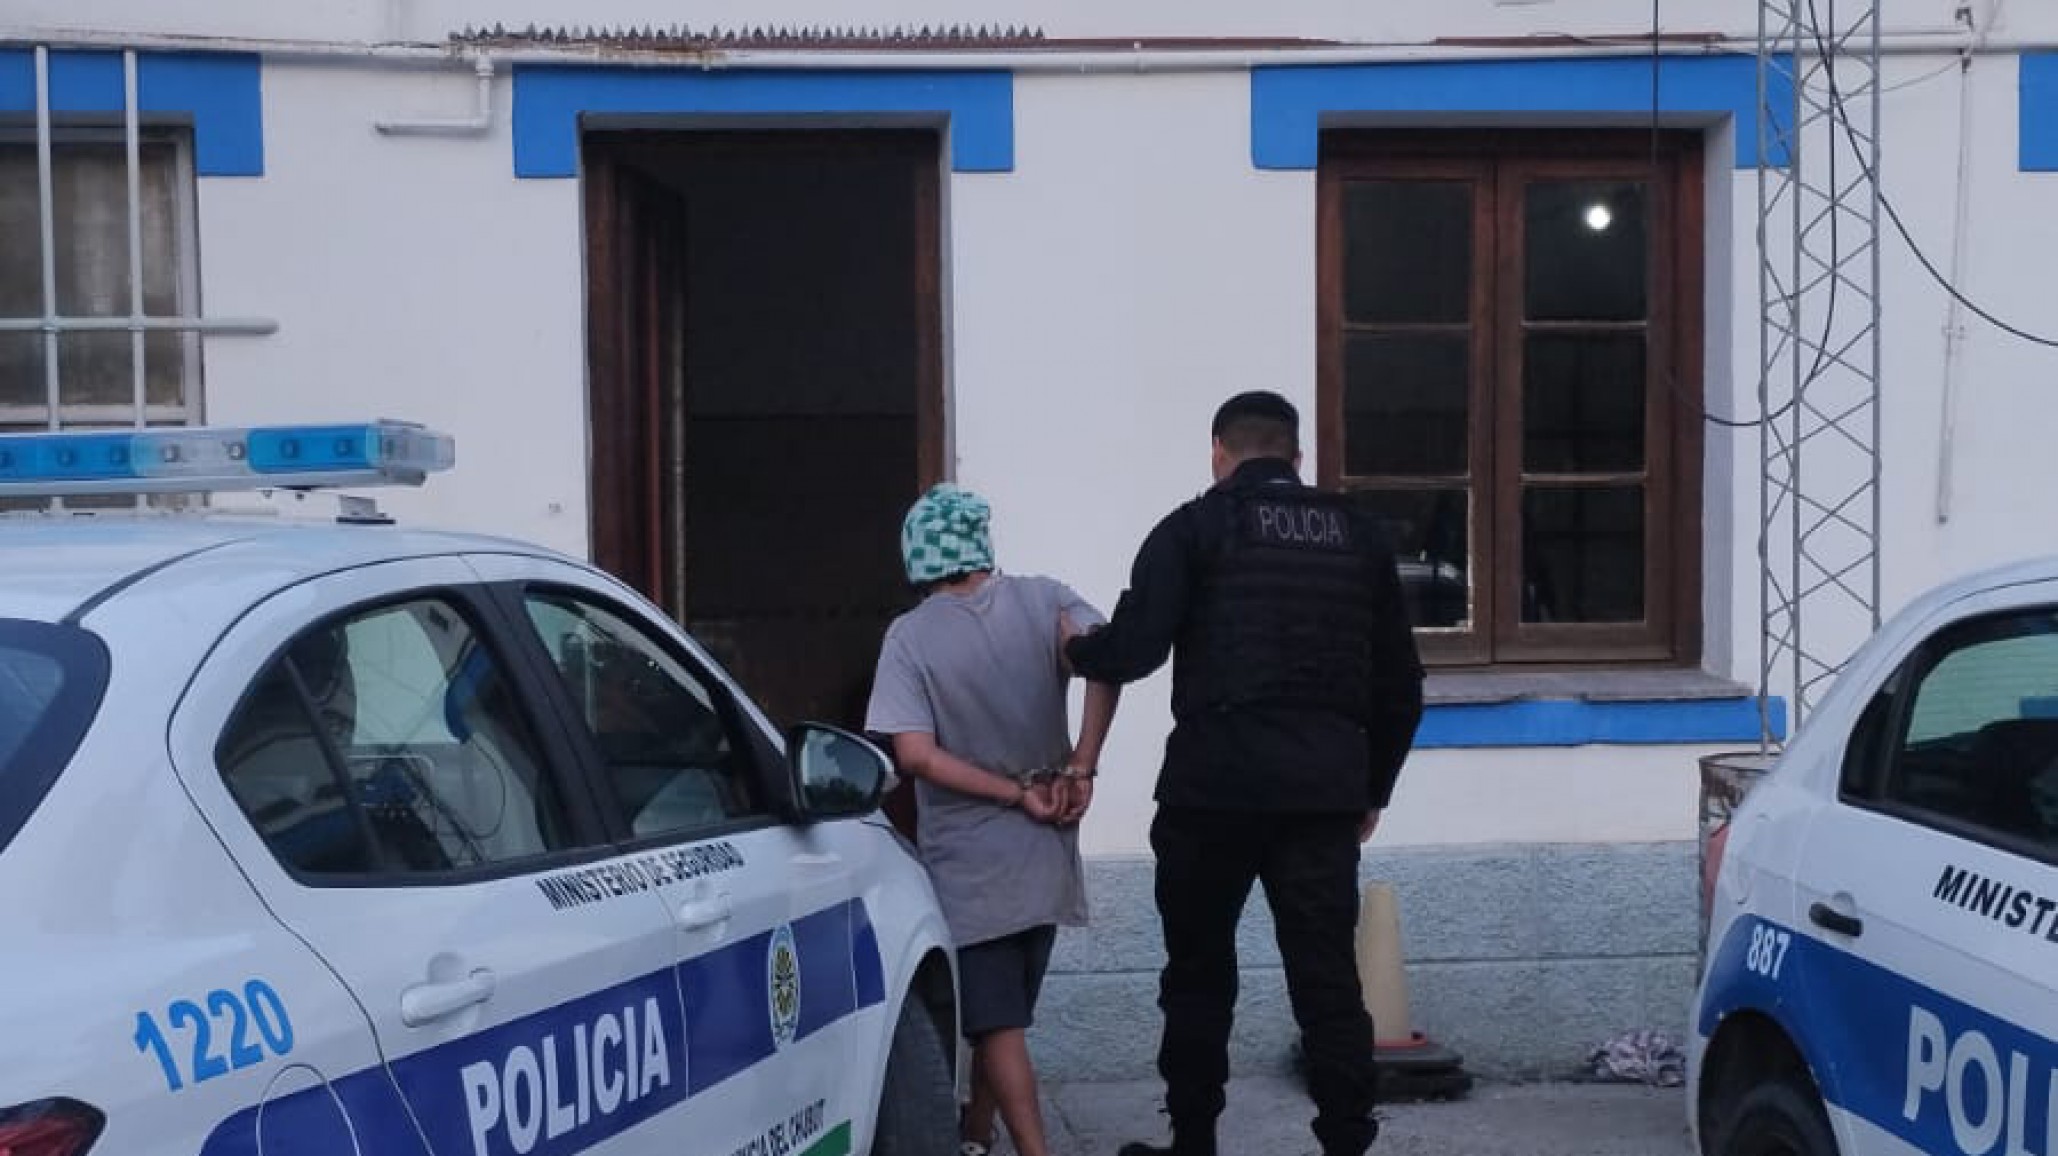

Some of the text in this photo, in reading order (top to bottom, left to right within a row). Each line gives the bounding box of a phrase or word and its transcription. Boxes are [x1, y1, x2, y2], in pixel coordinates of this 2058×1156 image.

[1259, 505, 1343, 545] POLICIA
[535, 841, 744, 911] MINISTERIO DE SEGURIDAD
[1747, 924, 1791, 980] 887
[134, 979, 294, 1092] 1220
[461, 997, 670, 1156] POLICIA
